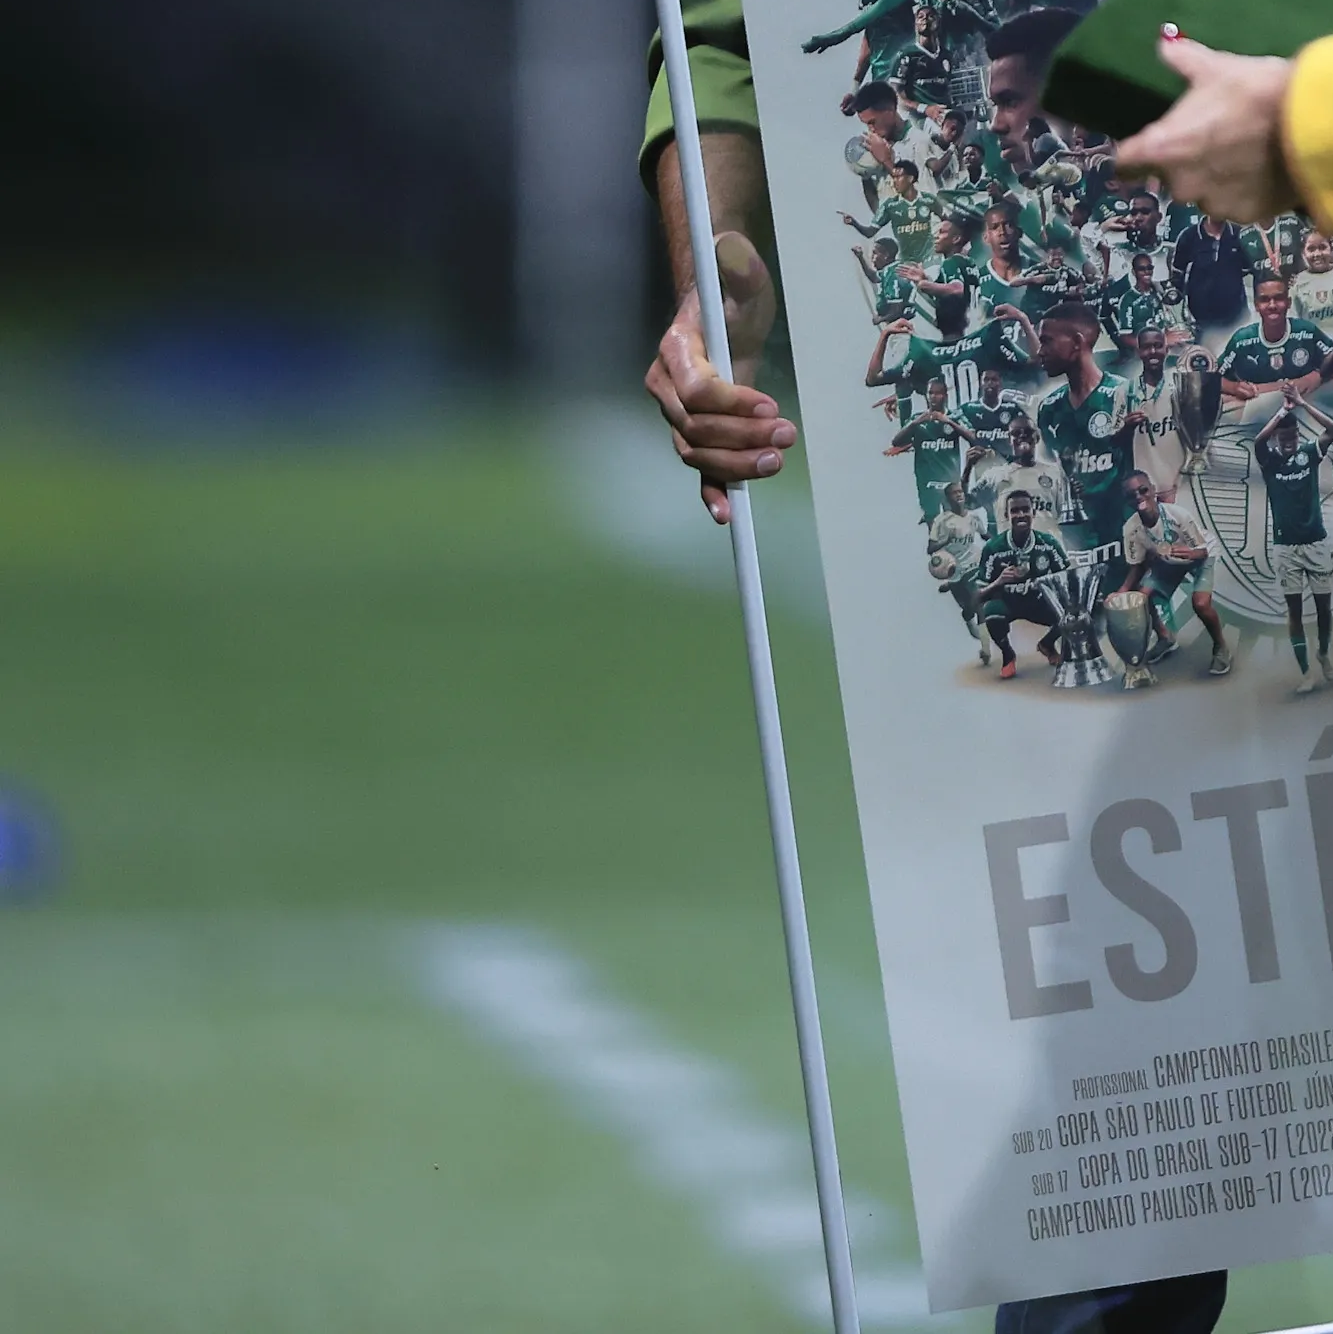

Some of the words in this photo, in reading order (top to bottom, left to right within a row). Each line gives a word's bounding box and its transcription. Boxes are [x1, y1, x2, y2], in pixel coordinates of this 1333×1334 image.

[932, 336, 983, 358] crefisa
[921, 438, 954, 452] crefisa
[1072, 1068, 1150, 1101] PROFISSIONAL
[1153, 1040, 1262, 1089] CAMPEONATO
[1012, 1131, 1035, 1155] SUB
[1037, 1127, 1053, 1151] 20
[1056, 1110, 1101, 1148] COPA
[1104, 1101, 1140, 1141] SÃO
[1142, 1095, 1196, 1135] PAULO
[1199, 1091, 1223, 1126] DE
[1226, 1080, 1298, 1122] FUTEBOL
[1031, 1172, 1055, 1197] SUB
[1056, 1169, 1068, 1193] 17
[1077, 1151, 1122, 1190] COPA
[1125, 1147, 1150, 1182] DO
[1153, 1137, 1213, 1178] BRASIL
[1216, 1126, 1278, 1169] SUB-17
[1026, 1193, 1137, 1242] CAMPEONATO
[1140, 1181, 1219, 1225] PAULISTA
[1221, 1170, 1282, 1213] SUB-17
